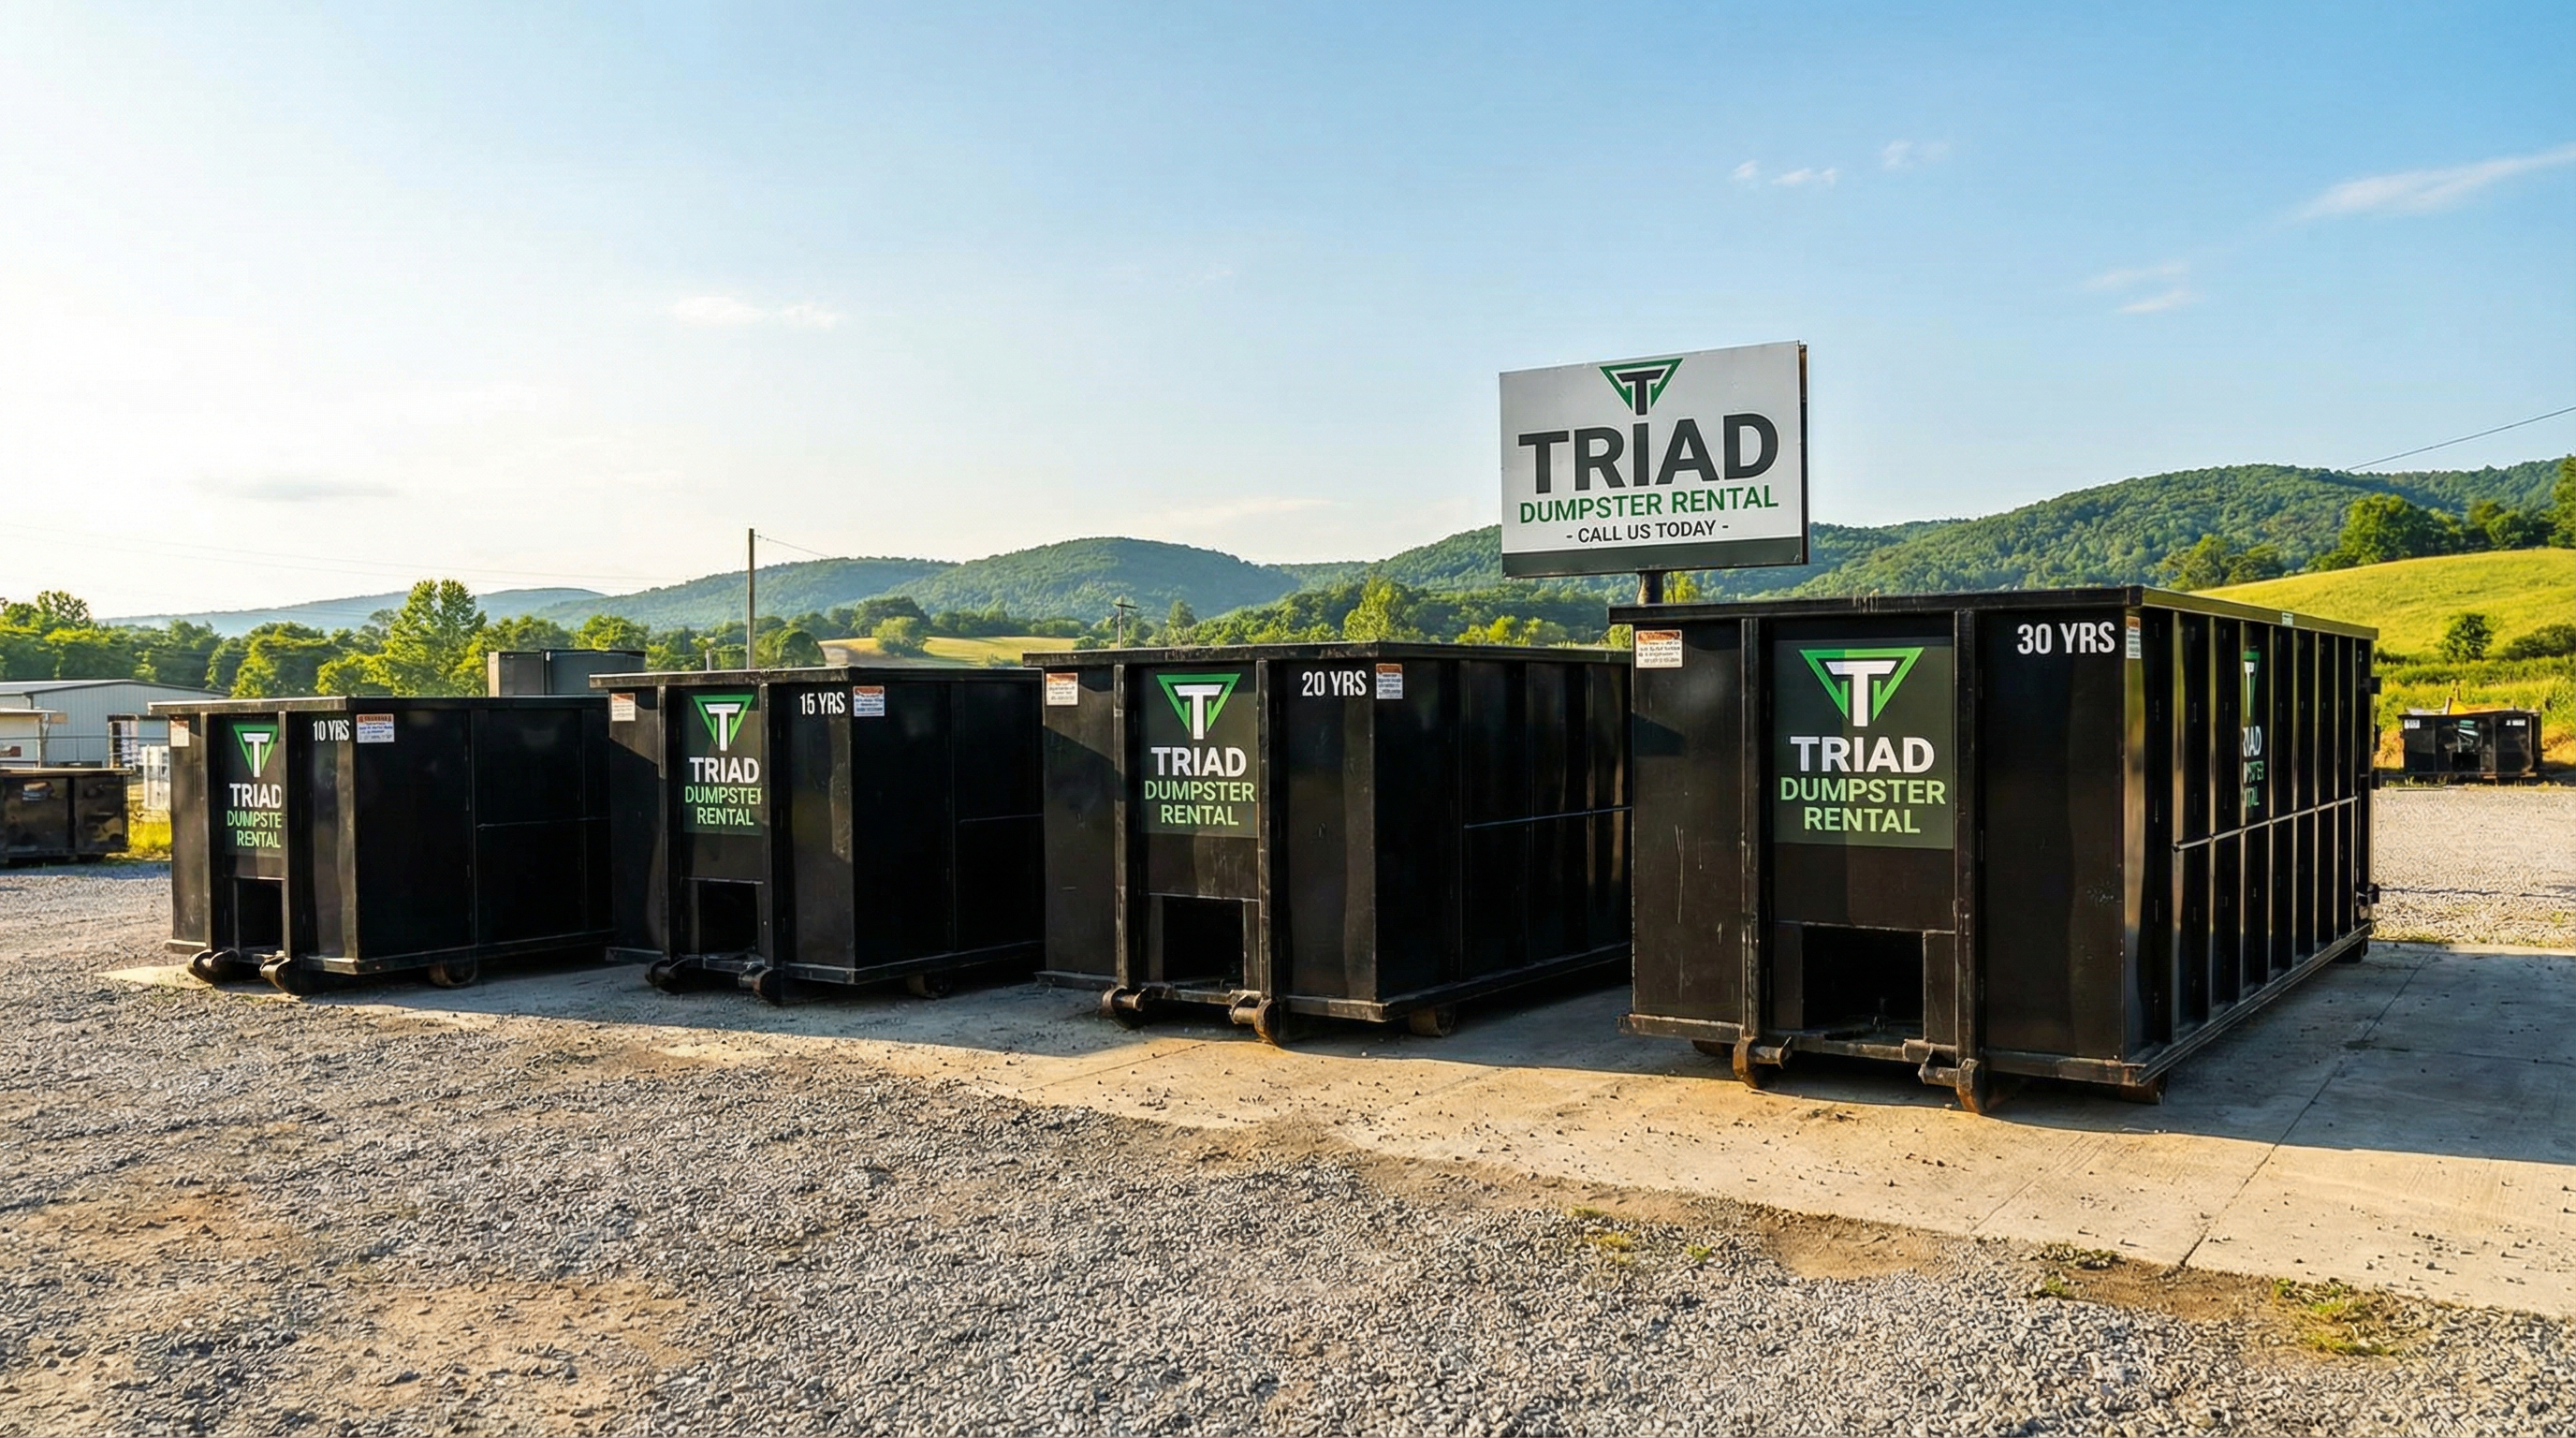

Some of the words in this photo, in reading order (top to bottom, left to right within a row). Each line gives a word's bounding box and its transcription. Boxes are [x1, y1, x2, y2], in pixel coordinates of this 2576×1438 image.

[1517, 412, 1778, 494] TRIAD
[1519, 492, 1662, 524] DUMPSTER
[1671, 484, 1779, 515] RENTAL
[1577, 525, 1622, 543] CALL
[1627, 523, 1651, 540] US
[1655, 520, 1717, 538] TODAY
[2016, 623, 2053, 654] 30
[2058, 621, 2115, 654] YRS
[1301, 670, 1325, 697] 20
[1329, 669, 1367, 697] YRS
[799, 693, 815, 715] 15
[818, 691, 845, 715] YRS
[313, 720, 327, 741] 10
[328, 719, 350, 741] YRS
[1149, 746, 1248, 777] TRIAD
[1789, 735, 1936, 773] TRIAD
[688, 756, 760, 784] TRIAD
[228, 783, 283, 809] TRIAD
[1144, 779, 1256, 803] DUMPSTER
[1779, 776, 1947, 805] DUMPSTER
[227, 810, 283, 829] DUMPSTE
[696, 806, 754, 826] RENTAL
[1160, 804, 1239, 827] RENTAL
[1803, 806, 1922, 834] RENTAL
[236, 829, 282, 848] RENTAL
